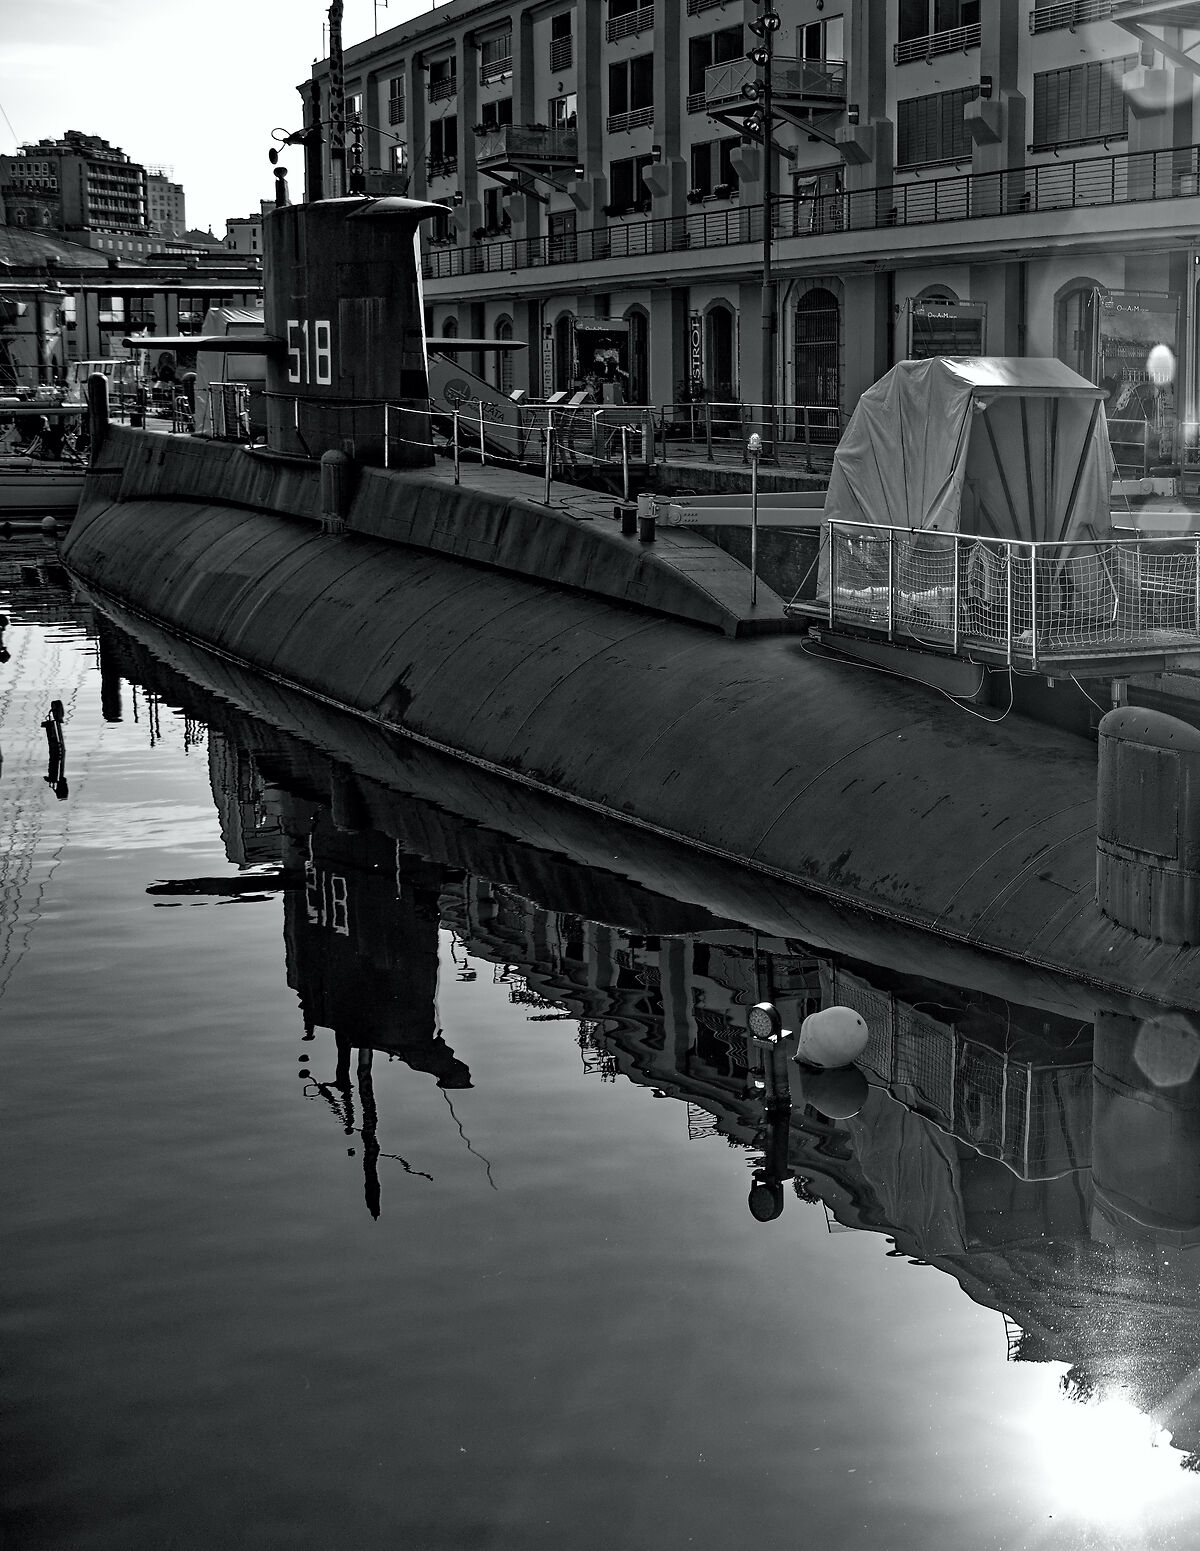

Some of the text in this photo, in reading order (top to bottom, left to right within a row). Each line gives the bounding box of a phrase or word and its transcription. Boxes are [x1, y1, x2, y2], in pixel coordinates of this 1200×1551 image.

[287, 320, 332, 386] 518
[692, 318, 701, 391] ISTROT
[470, 396, 504, 422] GLATA
